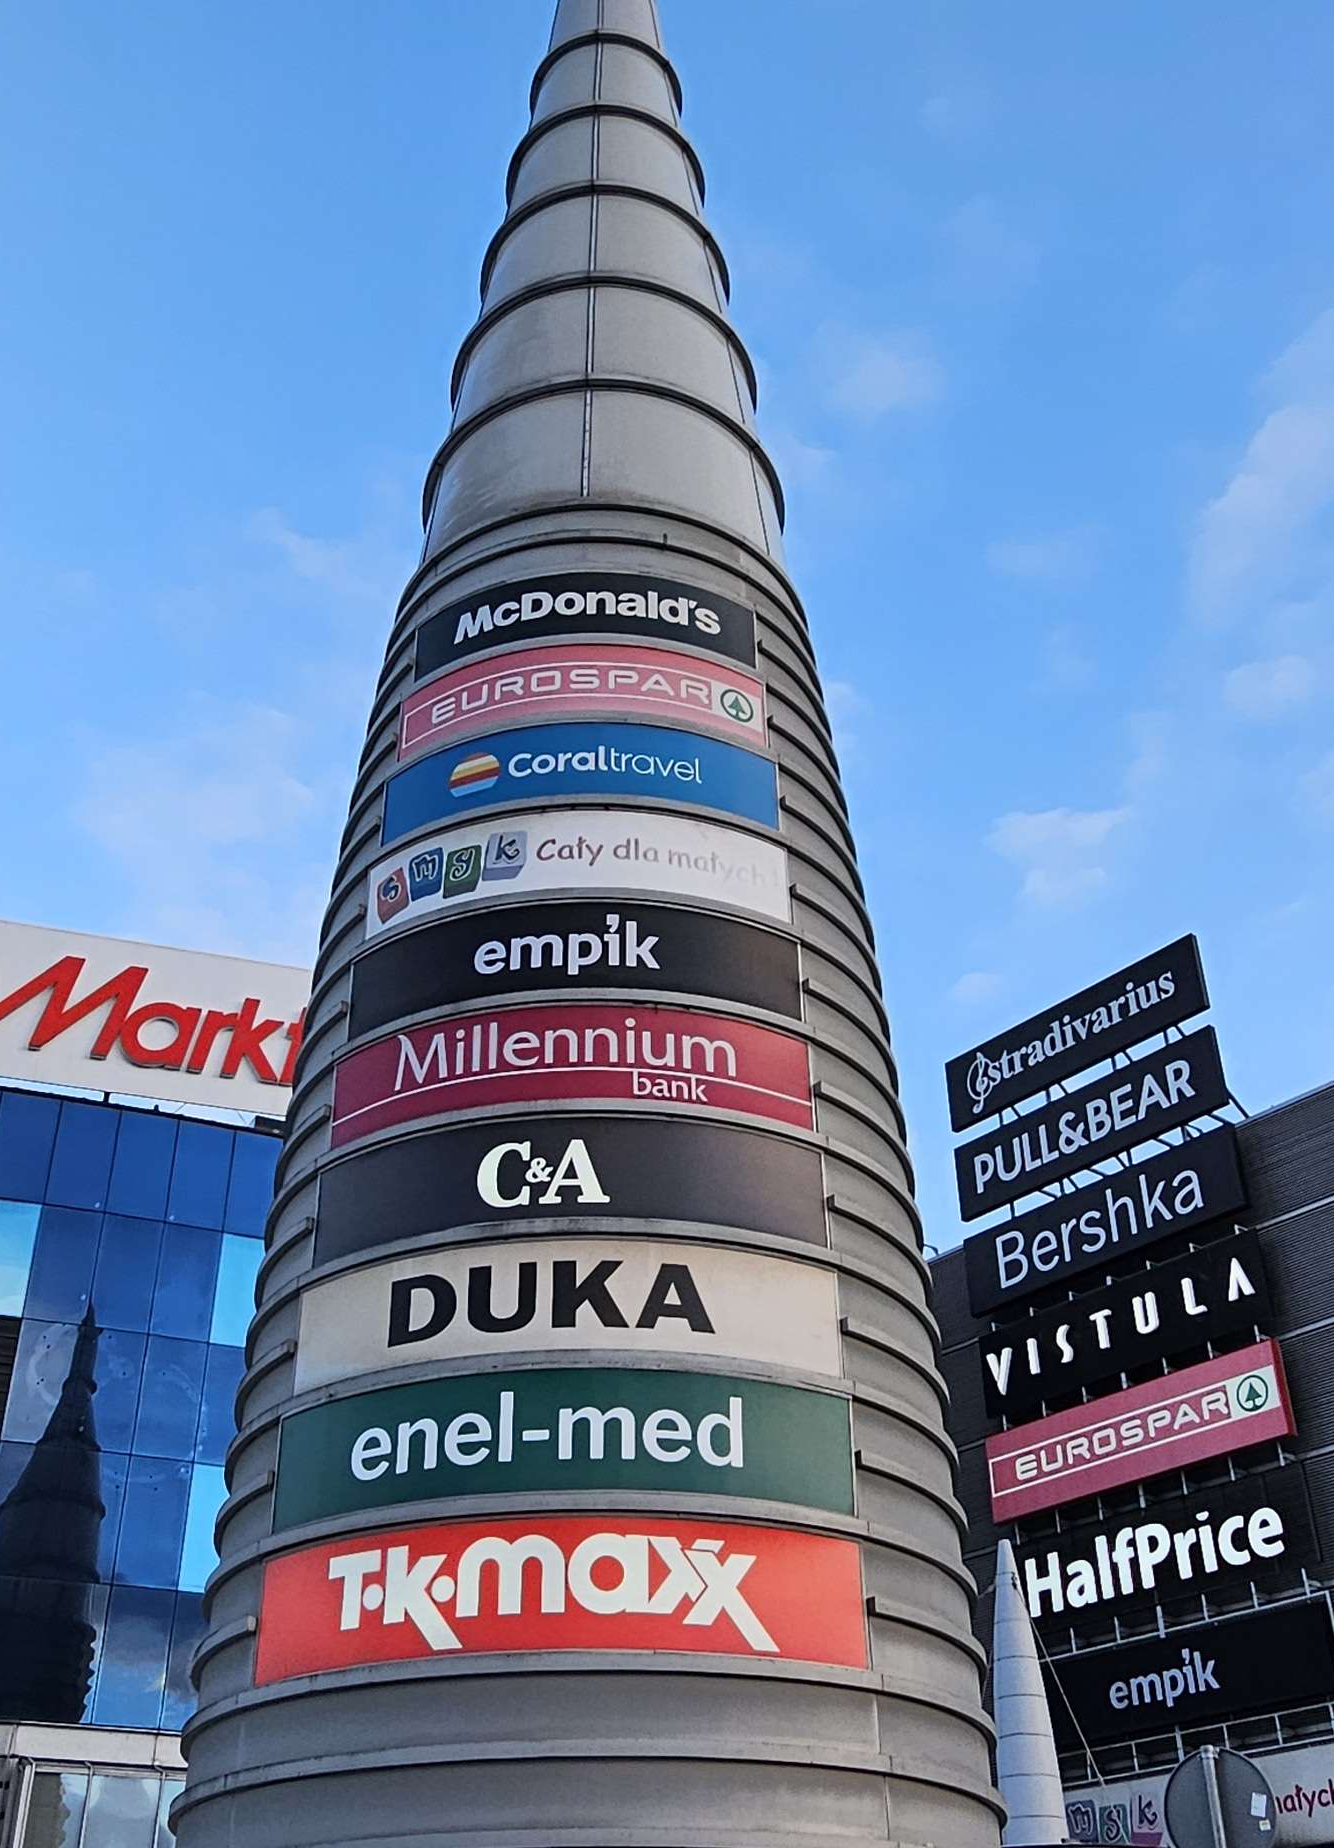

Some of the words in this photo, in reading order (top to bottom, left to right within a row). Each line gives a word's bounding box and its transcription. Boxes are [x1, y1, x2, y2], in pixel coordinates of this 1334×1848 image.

[454, 590, 721, 645] McDonald's
[432, 668, 711, 723] EUROSPAR
[536, 835, 604, 867] Cały
[612, 837, 660, 863] dla
[474, 913, 661, 975] empik
[393, 1018, 736, 1091] Millennium
[989, 971, 1175, 1088] stradivarius
[633, 1069, 708, 1103] bank
[973, 1059, 1196, 1194] PULL&BEAR
[477, 1138, 610, 1208] C&A
[995, 1169, 1205, 1290] Bershka
[387, 1260, 715, 1348] DUKA
[986, 1257, 1255, 1395] VISTULA
[351, 1391, 743, 1482] enel-med
[1015, 1388, 1229, 1482] EUROSPAR
[1025, 1507, 1285, 1618] HalfPrice
[1109, 1648, 1221, 1709] empik
